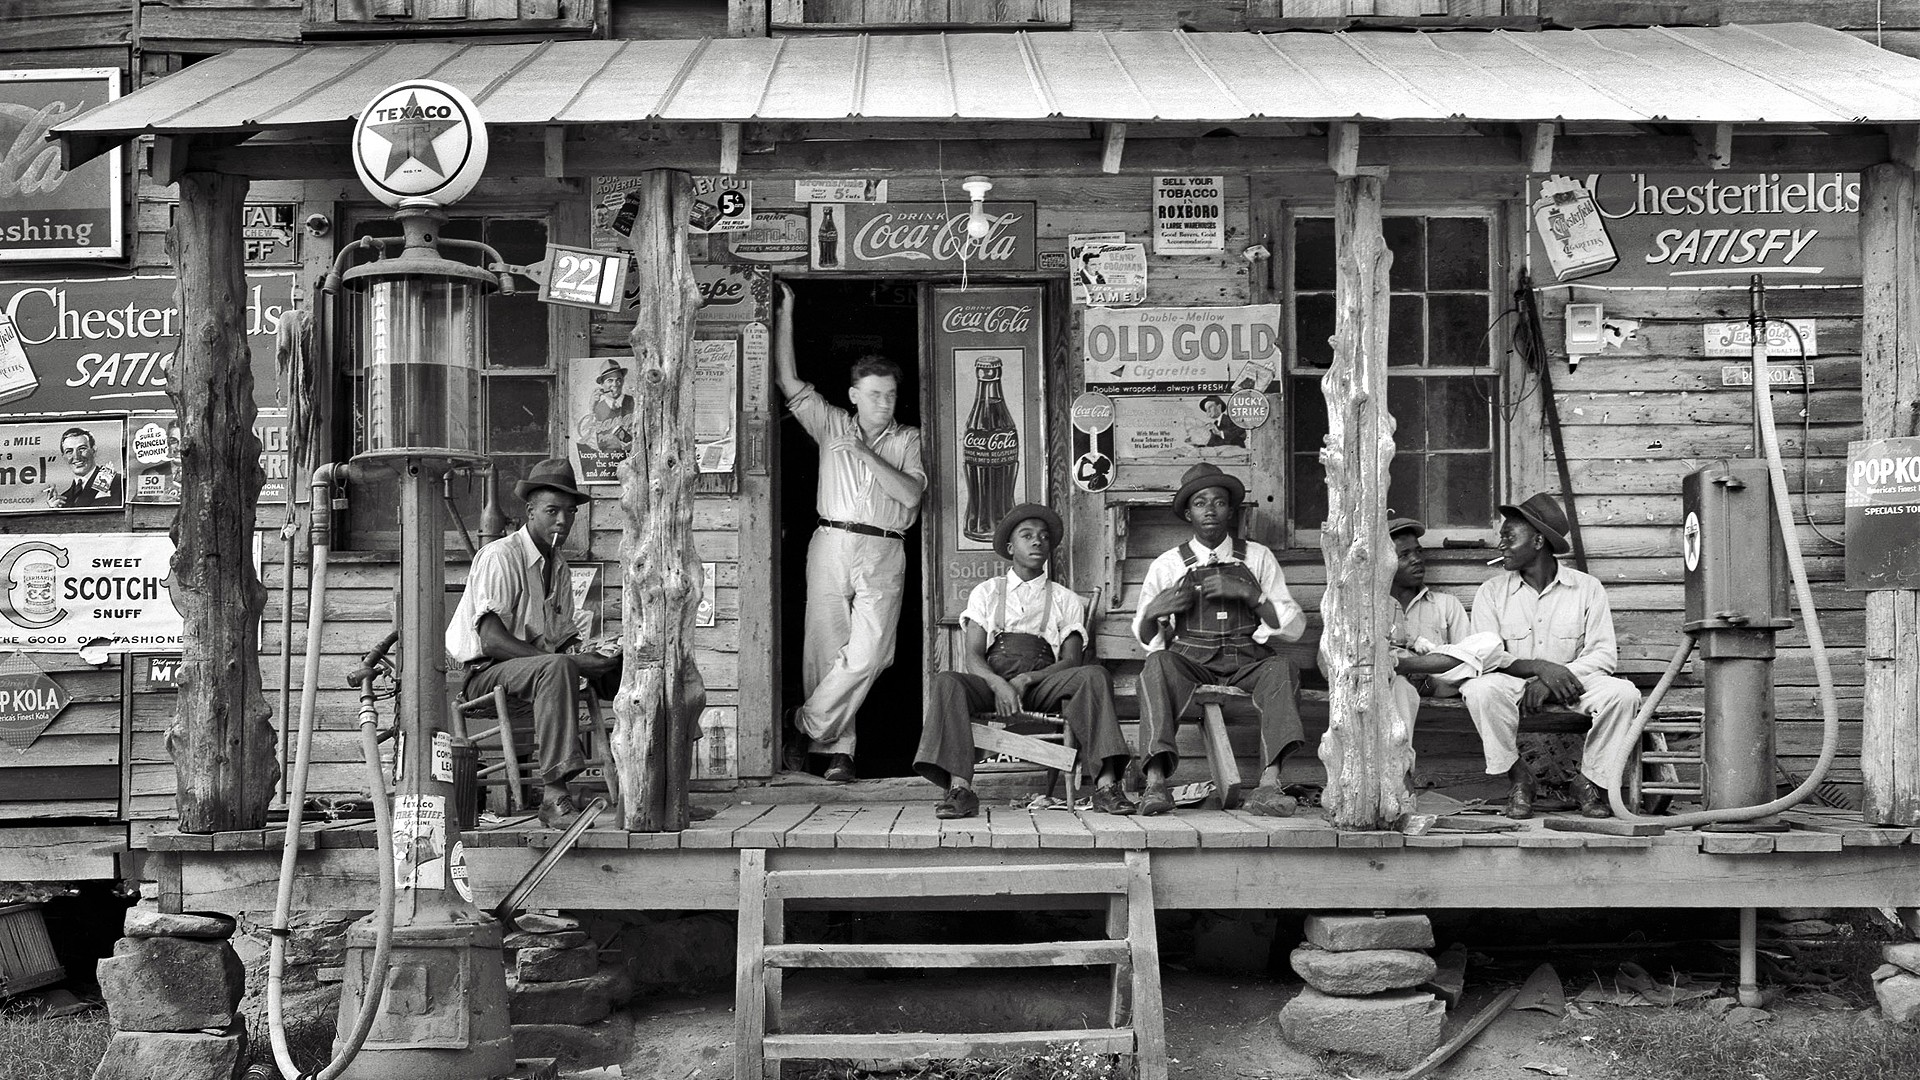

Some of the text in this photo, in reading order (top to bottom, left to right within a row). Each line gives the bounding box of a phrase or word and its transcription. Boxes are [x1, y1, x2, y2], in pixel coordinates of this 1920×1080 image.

[376, 106, 452, 121] TEXACO
[1162, 178, 1213, 186] SELL YOUR
[1158, 188, 1218, 198] TOBACCO
[1585, 174, 1860, 219] Chesterfields
[1158, 205, 1219, 219] ROXBORO
[853, 212, 1023, 261] Coca-Cola
[1645, 229, 1819, 264] SATISFY
[697, 278, 743, 301] ape
[942, 305, 1031, 333] Coca-Cola
[1088, 323, 1277, 362] OLD GOLD
[1133, 365, 1207, 380] Cigarettes
[1093, 385, 1120, 393] Double
[1167, 384, 1195, 393] always
[1197, 383, 1229, 393] FRESH!
[1233, 397, 1263, 406] LUCKY
[1231, 407, 1265, 417] STRIKE
[14, 436, 41, 446] MILE
[135, 439, 166, 450] PRINCELY
[964, 431, 1017, 450] Coca-Cola
[580, 450, 625, 460] keeps the pipe
[586, 469, 598, 477] and
[145, 476, 159, 485] 50
[1898, 485, 1917, 493] Finest
[1864, 505, 1904, 516] SPECIALS
[92, 558, 142, 568] SWEET
[949, 562, 987, 578] Sold
[64, 577, 158, 600] SCOTCH
[93, 609, 142, 619] SNUFF
[27, 636, 67, 644] GOOD
[13, 688, 60, 712] KOLA
[17, 713, 34, 721] Finest
[35, 713, 49, 721] Kola
